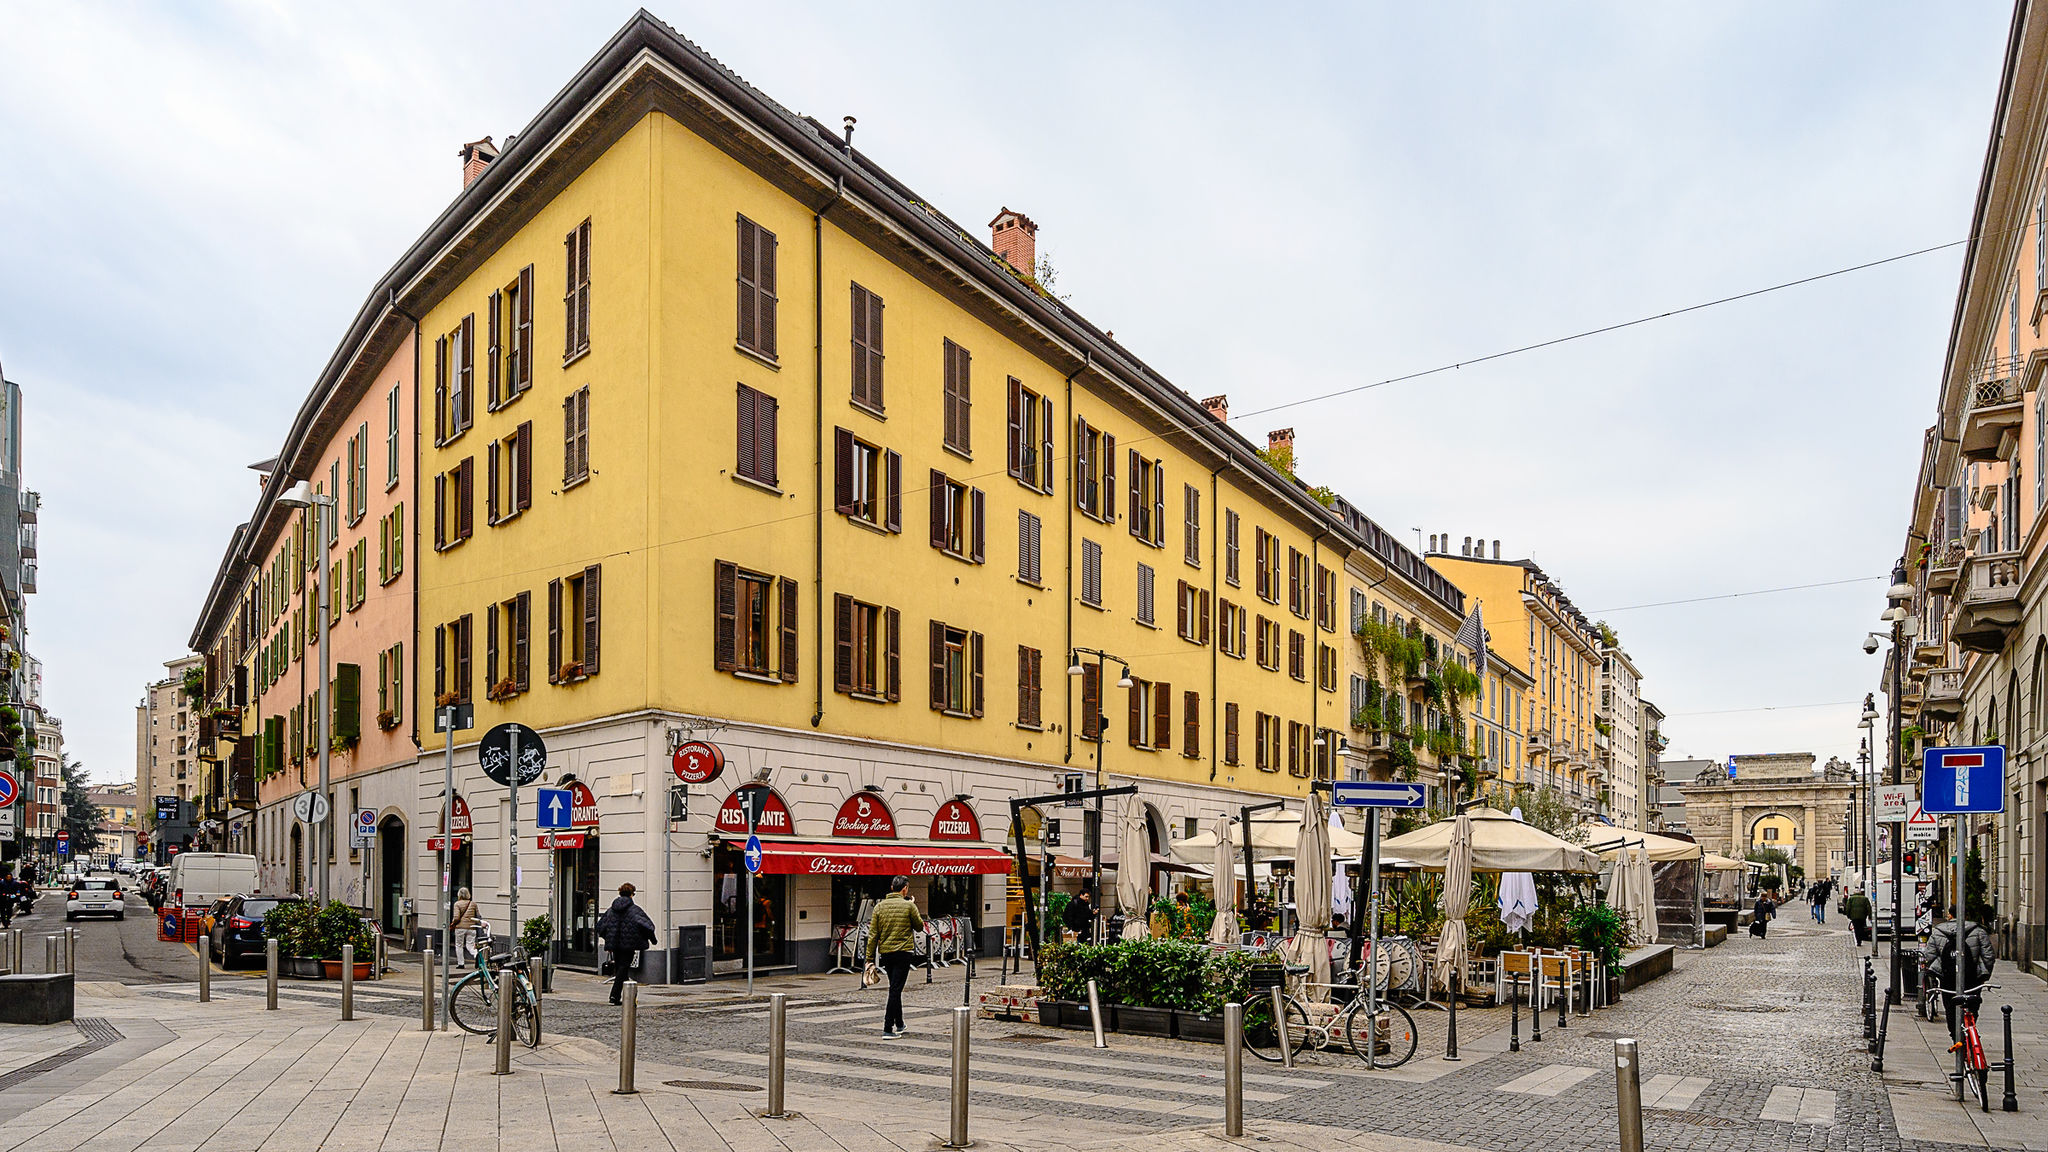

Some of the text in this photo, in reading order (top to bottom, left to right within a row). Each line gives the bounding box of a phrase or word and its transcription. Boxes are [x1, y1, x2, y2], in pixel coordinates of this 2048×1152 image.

[678, 745, 710, 758] RISTORANTE
[681, 769, 707, 780] PIZZERIA
[1883, 792, 1905, 800] Wi-Fi
[299, 800, 325, 815] 30
[571, 806, 598, 822] ORANTE
[721, 808, 785, 826] RISTANTE
[836, 817, 891, 834] Rocking Horse
[938, 820, 971, 835] PIZZERIA
[809, 857, 855, 873] Pizza
[911, 860, 976, 875] Ristorante
